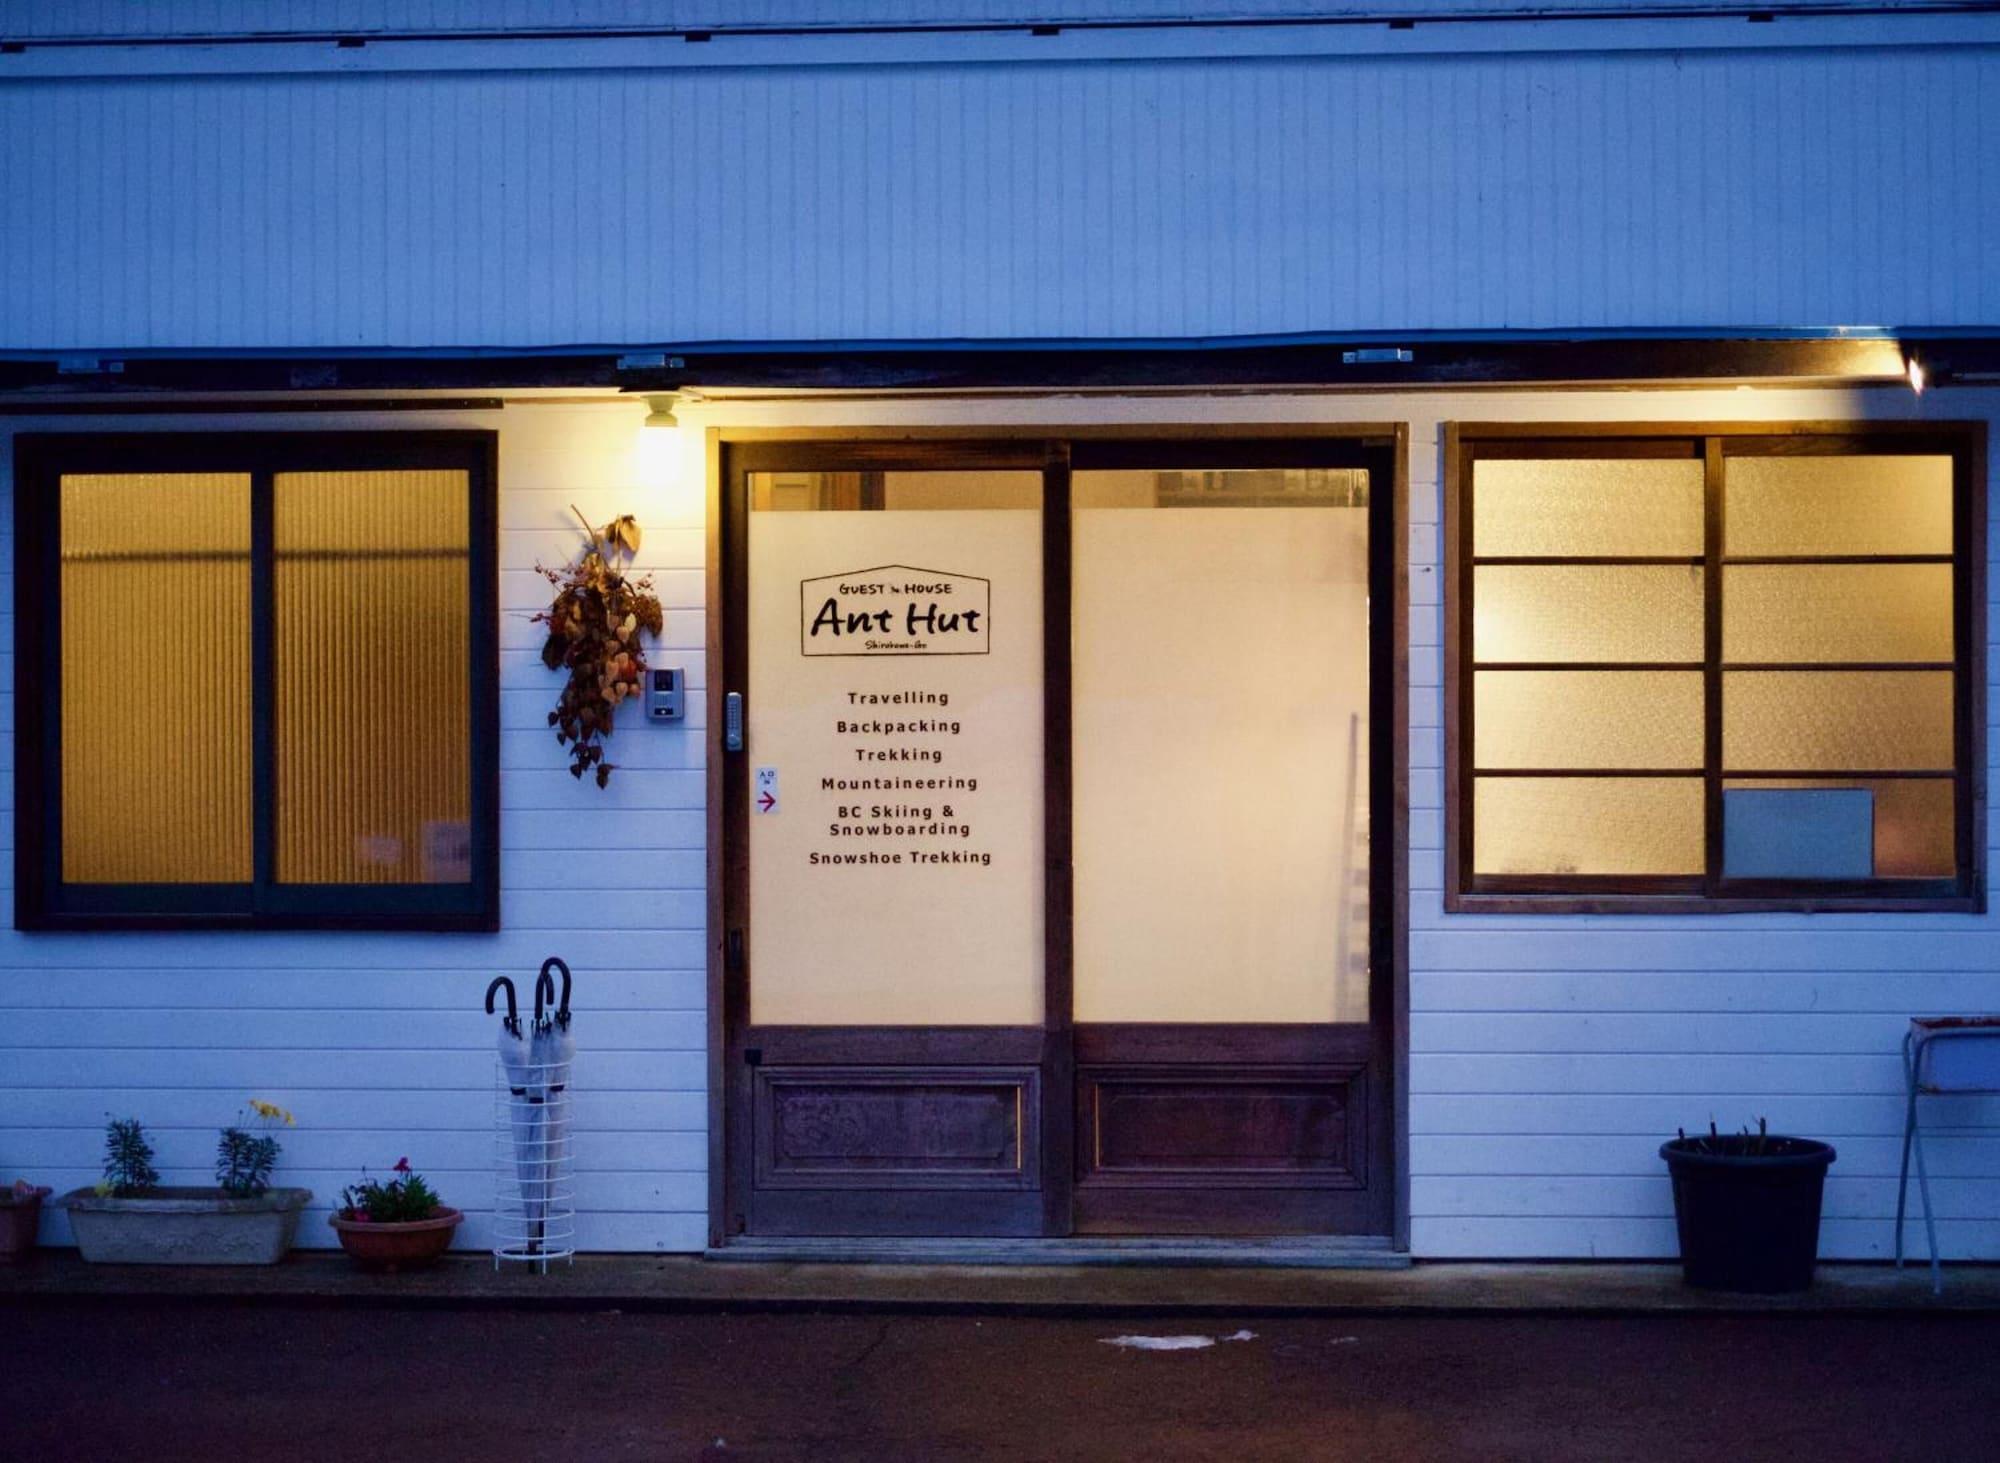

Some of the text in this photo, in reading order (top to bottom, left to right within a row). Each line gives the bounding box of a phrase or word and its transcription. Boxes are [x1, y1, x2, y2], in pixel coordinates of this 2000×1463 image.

[839, 583, 952, 596] GUEST HOUSE
[810, 597, 981, 637] Ant Hut
[847, 690, 949, 706] Travelling
[836, 719, 961, 735] Backpacking
[855, 747, 942, 763] Trekking
[821, 775, 978, 792] Mountaineering
[838, 804, 954, 820] BC Skiing &
[829, 822, 970, 838] Snowboarding
[809, 850, 991, 866] Snowshoe Trekking
